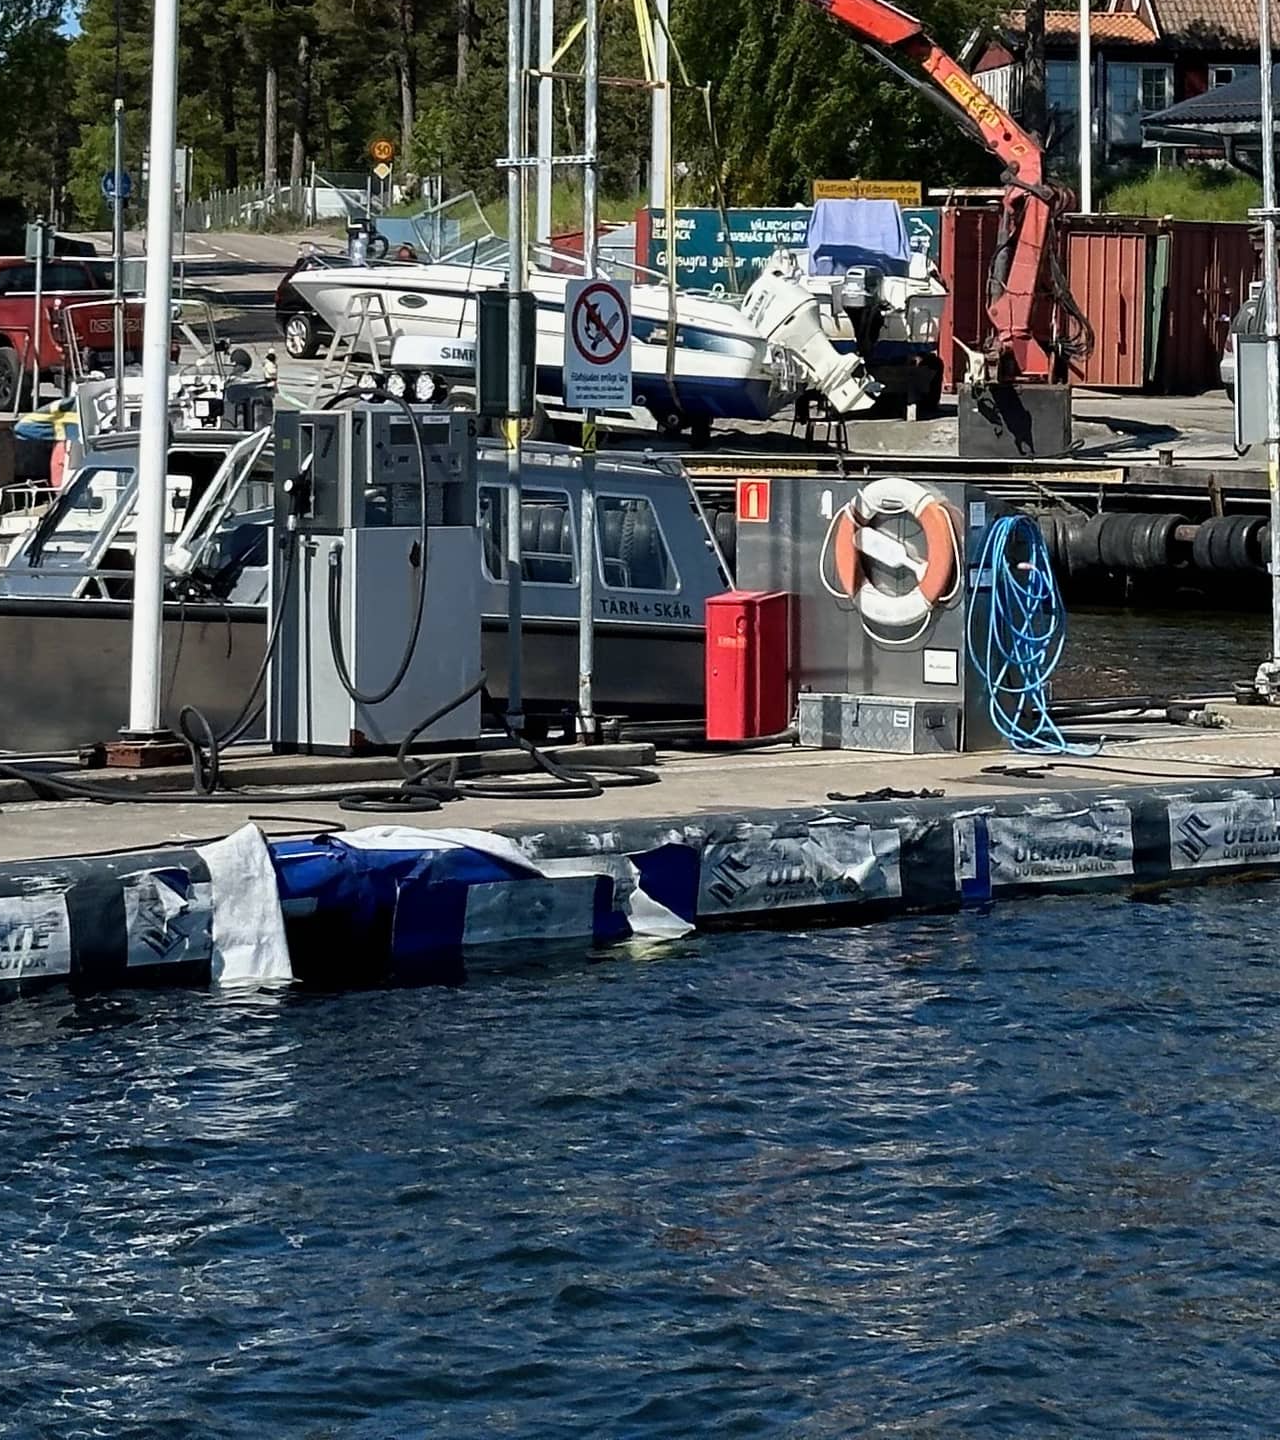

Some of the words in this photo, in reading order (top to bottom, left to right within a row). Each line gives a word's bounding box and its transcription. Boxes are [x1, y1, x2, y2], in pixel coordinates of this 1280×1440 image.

[439, 346, 478, 362] SIMR
[353, 418, 365, 436] 7
[319, 425, 335, 458] 7
[600, 598, 639, 615] TÄRN
[654, 599, 693, 619] SKÄR
